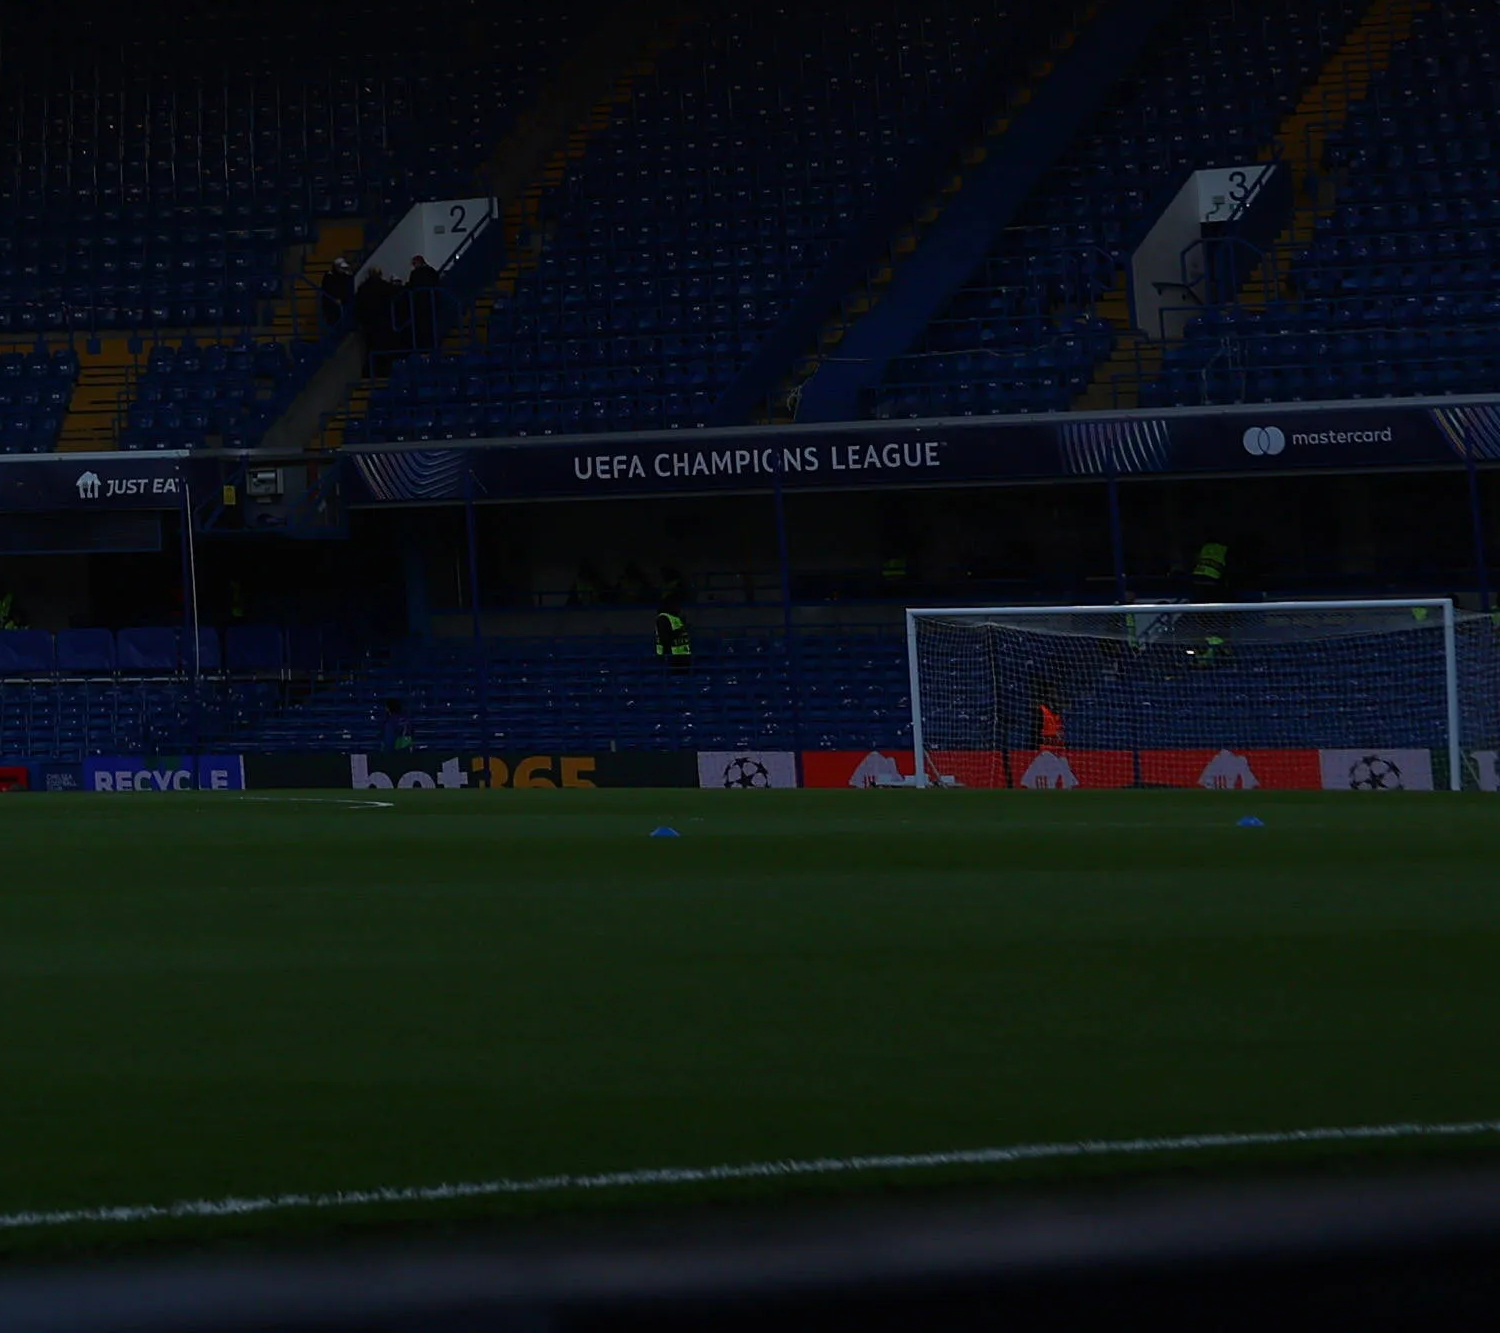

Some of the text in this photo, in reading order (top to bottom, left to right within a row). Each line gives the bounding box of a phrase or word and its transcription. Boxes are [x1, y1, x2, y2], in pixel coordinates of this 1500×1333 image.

[1229, 171, 1250, 202] 3
[450, 206, 467, 232] 2
[1292, 427, 1393, 446] mastercard
[574, 454, 646, 480] UEFA
[106, 479, 149, 497] JUST
[95, 769, 229, 791] RECYCE
[351, 753, 598, 789] bet365
